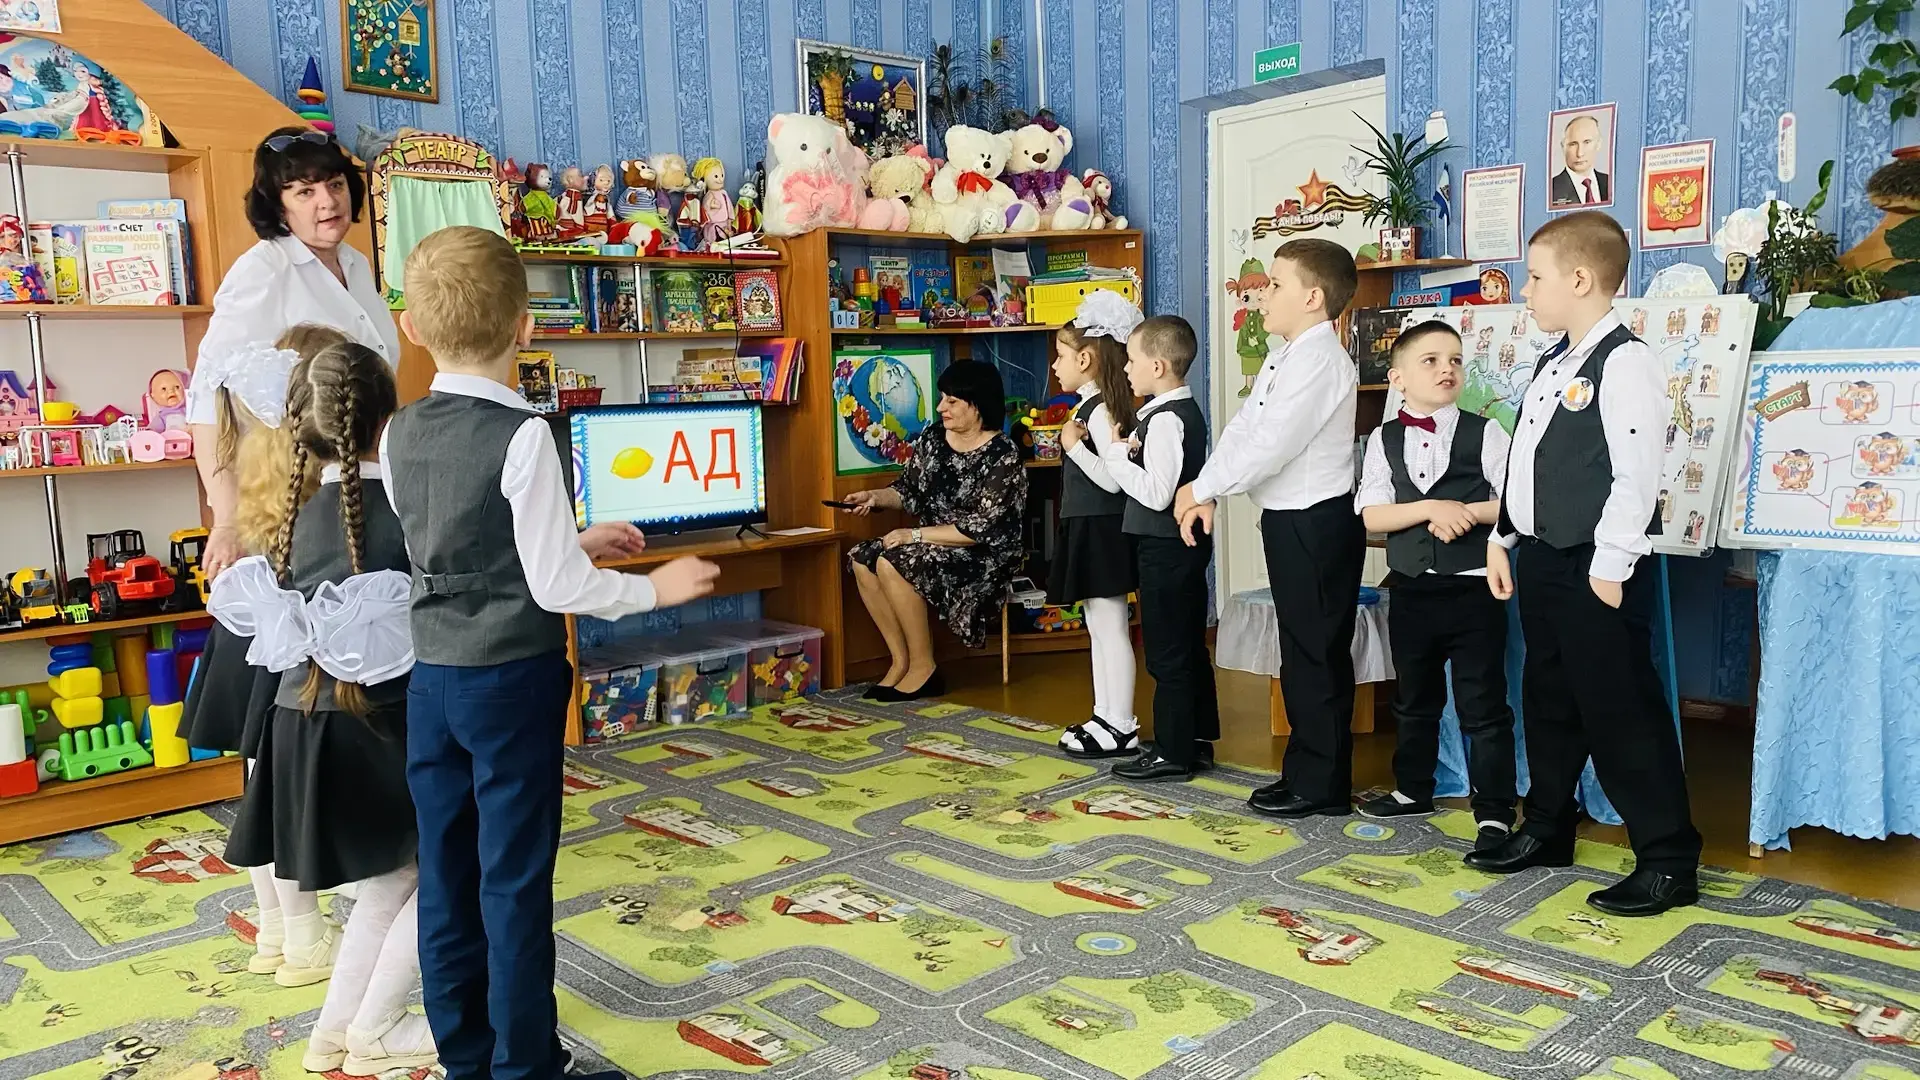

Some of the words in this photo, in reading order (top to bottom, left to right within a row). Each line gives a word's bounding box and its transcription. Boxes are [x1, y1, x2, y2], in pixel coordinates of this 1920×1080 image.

[1258, 56, 1297, 73] ВЫХОД
[413, 140, 468, 162] ТЕАТР
[87, 233, 160, 243] РАЗВИВАЮЩЕЕ
[133, 242, 160, 251] ЛОТО
[1397, 292, 1443, 306] АЗБУКА
[1765, 390, 1803, 414] СТАРТ
[663, 428, 741, 492] АД
